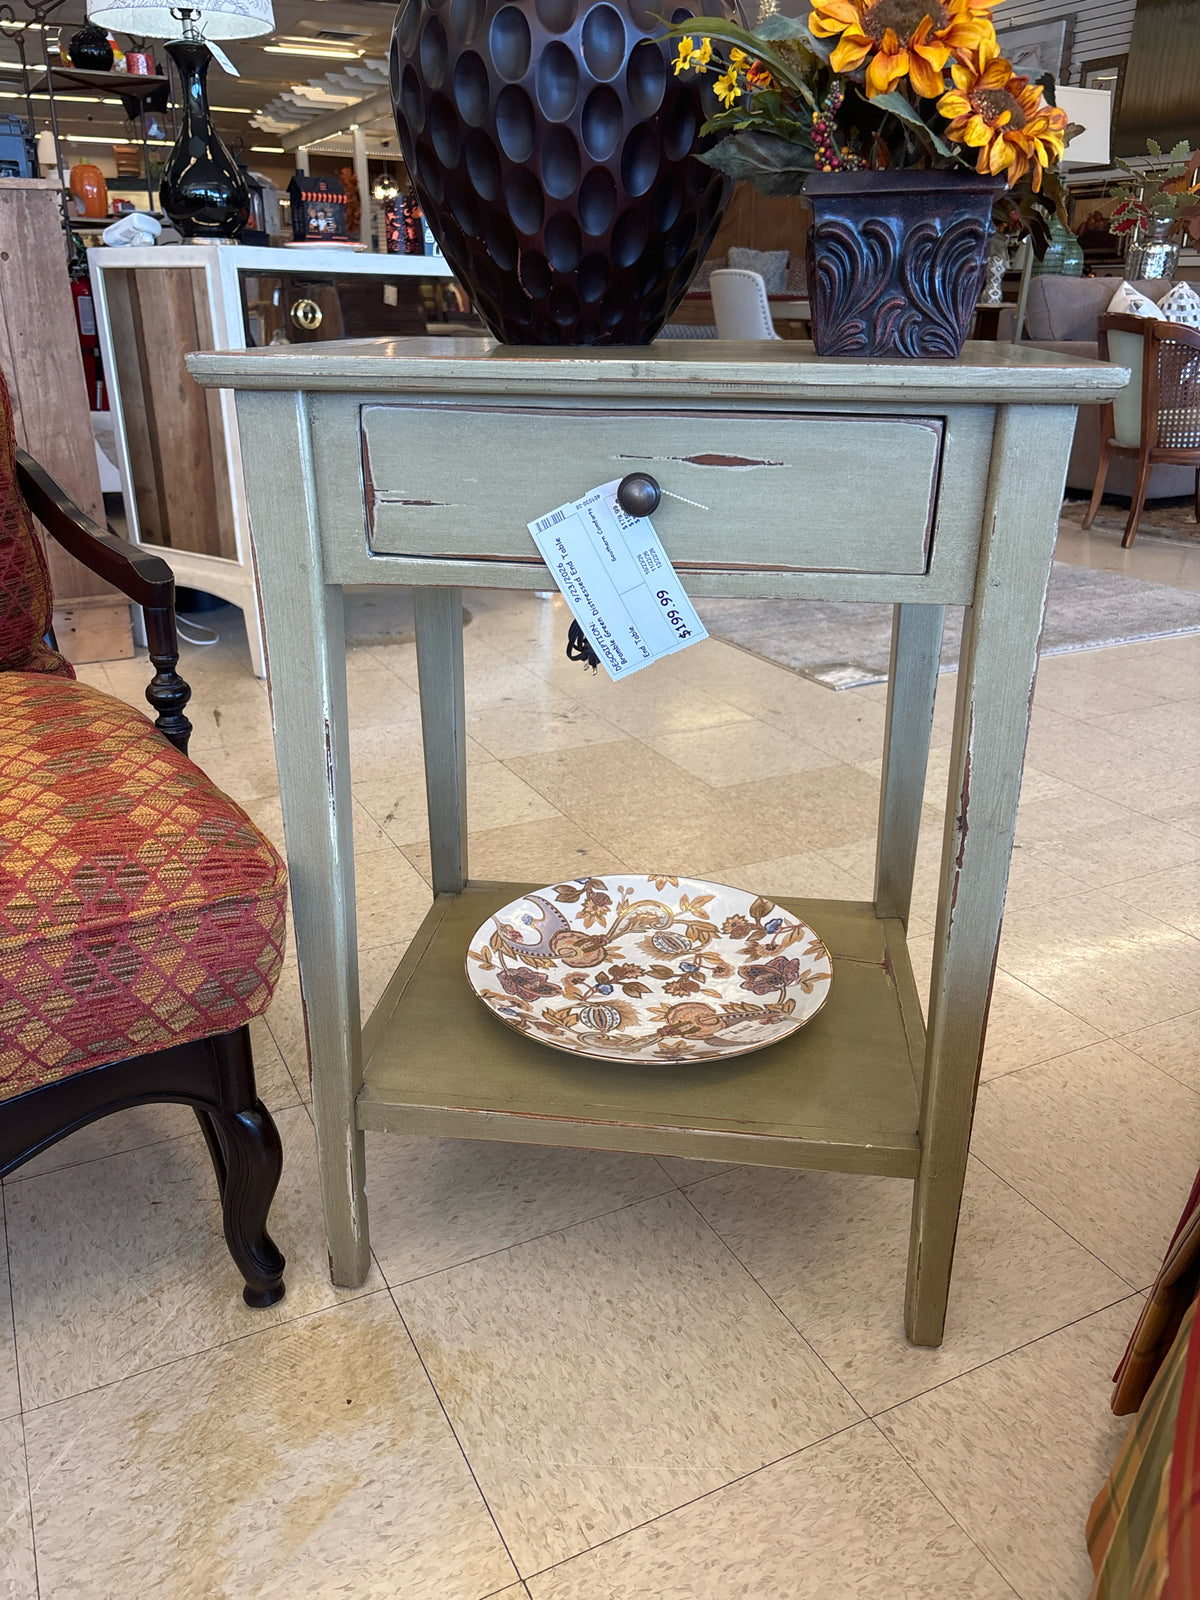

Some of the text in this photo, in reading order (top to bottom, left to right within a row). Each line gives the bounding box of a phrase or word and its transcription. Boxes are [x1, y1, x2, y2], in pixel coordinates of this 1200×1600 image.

[587, 508, 617, 562] Southern Comforts
[612, 505, 628, 530] $179.99
[555, 537, 628, 665] Bramble Green Distressed End Table
[557, 562, 582, 602] 9/23/2026
[656, 590, 692, 639] $199.99
[588, 621, 622, 672] DESCRIPTION:
[629, 626, 650, 658] End Table
